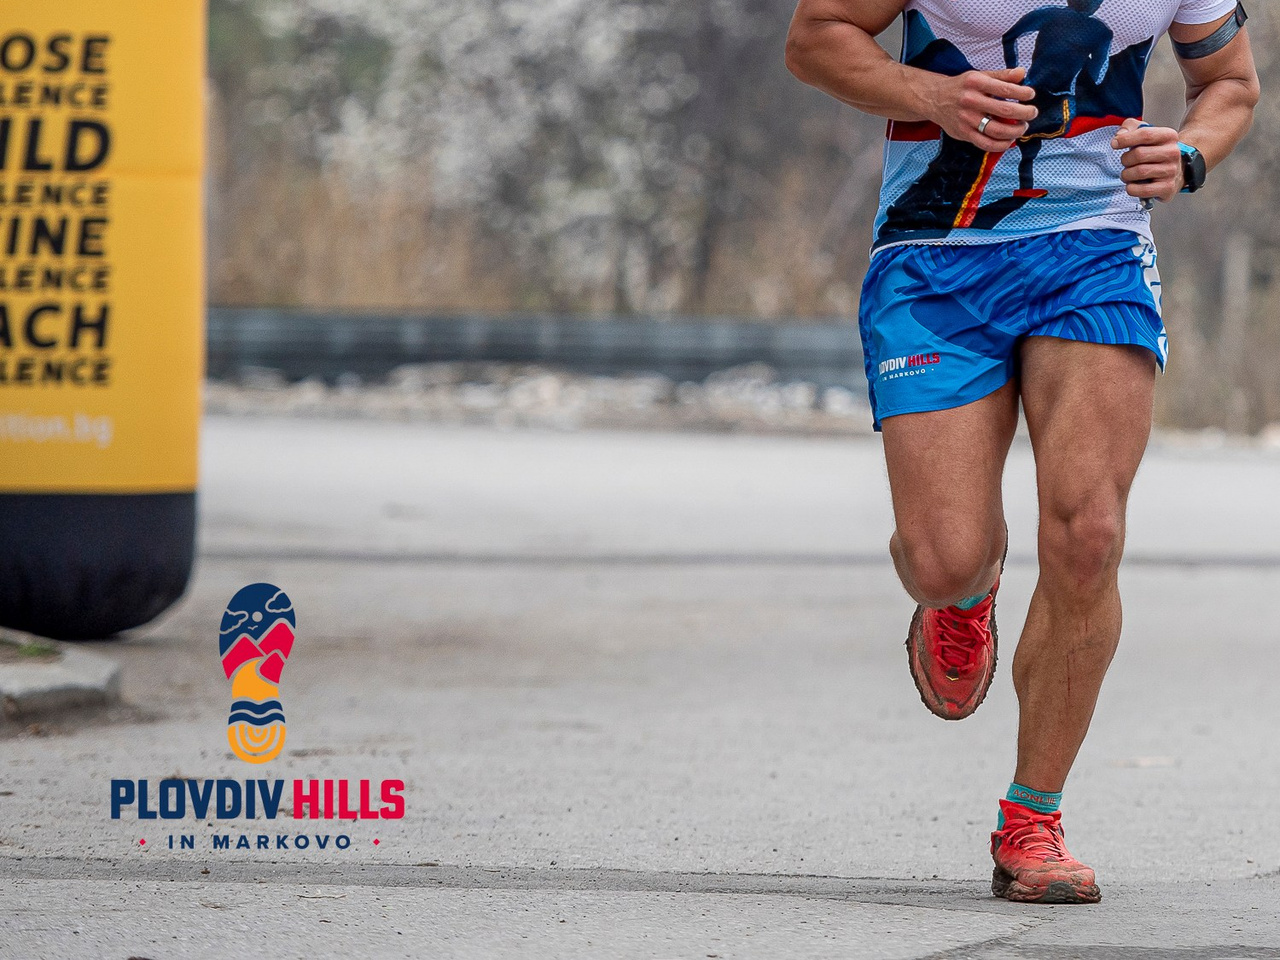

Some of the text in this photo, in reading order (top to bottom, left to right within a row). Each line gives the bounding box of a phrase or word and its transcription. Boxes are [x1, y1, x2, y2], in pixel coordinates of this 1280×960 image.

[1, 32, 110, 74] OSE
[0, 216, 109, 256] INE
[907, 352, 940, 367] HILLS
[889, 368, 926, 380] MARKOVO
